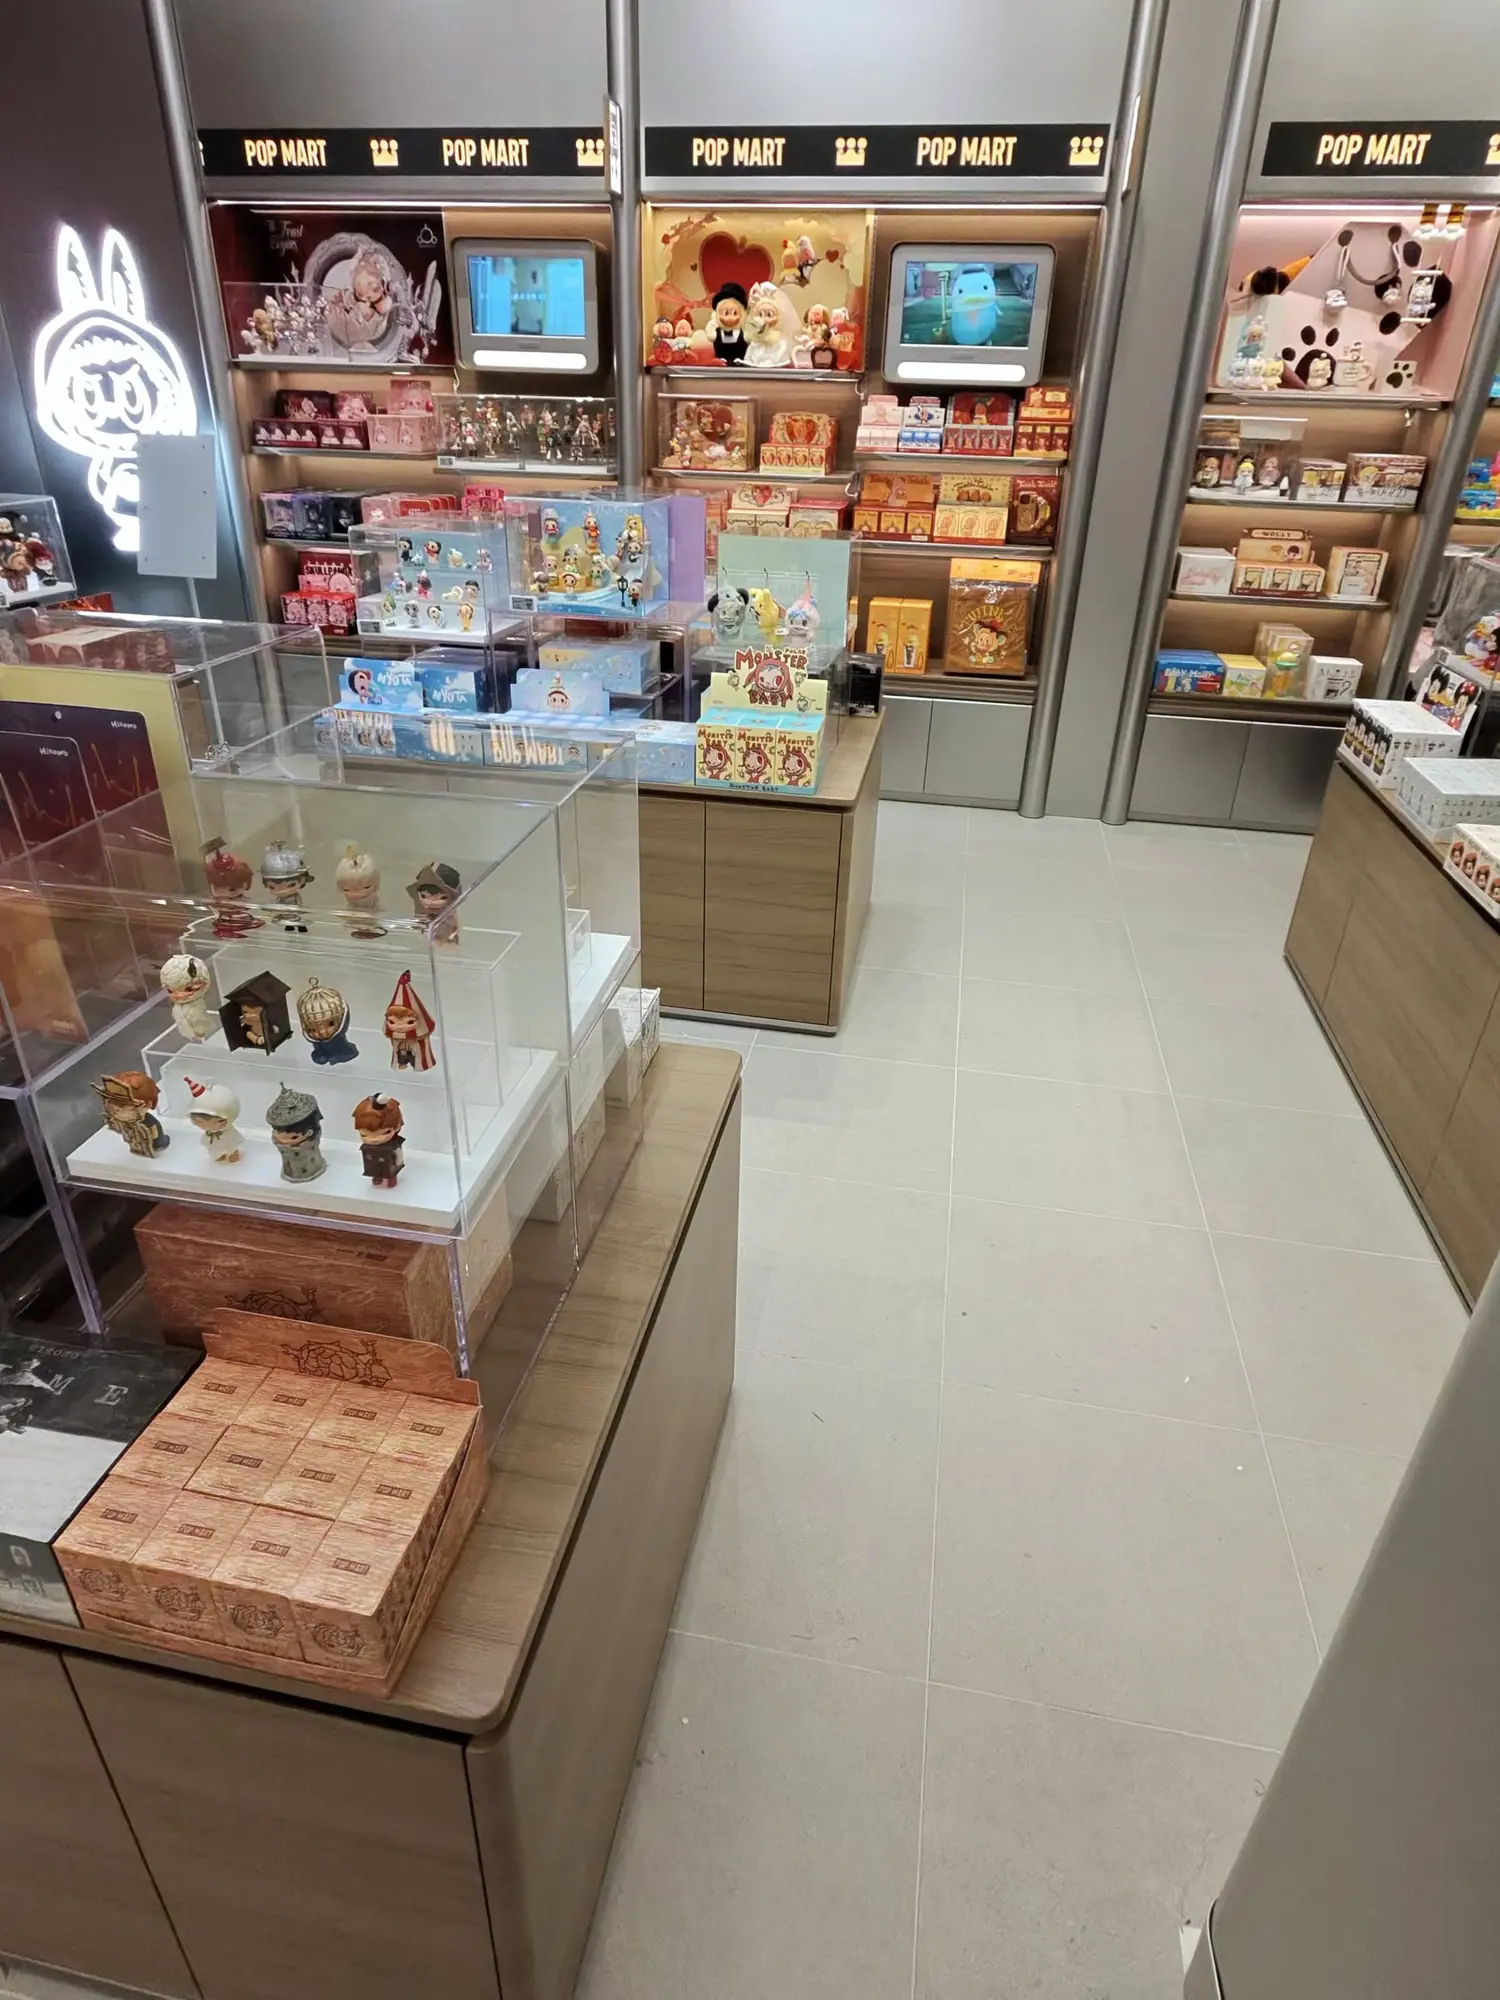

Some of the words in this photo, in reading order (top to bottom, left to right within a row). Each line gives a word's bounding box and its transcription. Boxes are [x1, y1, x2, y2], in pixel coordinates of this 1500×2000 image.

[244, 139, 278, 167] POP
[282, 139, 327, 167] MART
[442, 138, 477, 167] POP
[480, 138, 529, 167] MART
[692, 137, 729, 166] POP
[733, 137, 786, 166] MART
[916, 136, 956, 166] POP
[960, 136, 1018, 166] MART
[1316, 133, 1362, 166] POP
[1364, 133, 1431, 166] MART
